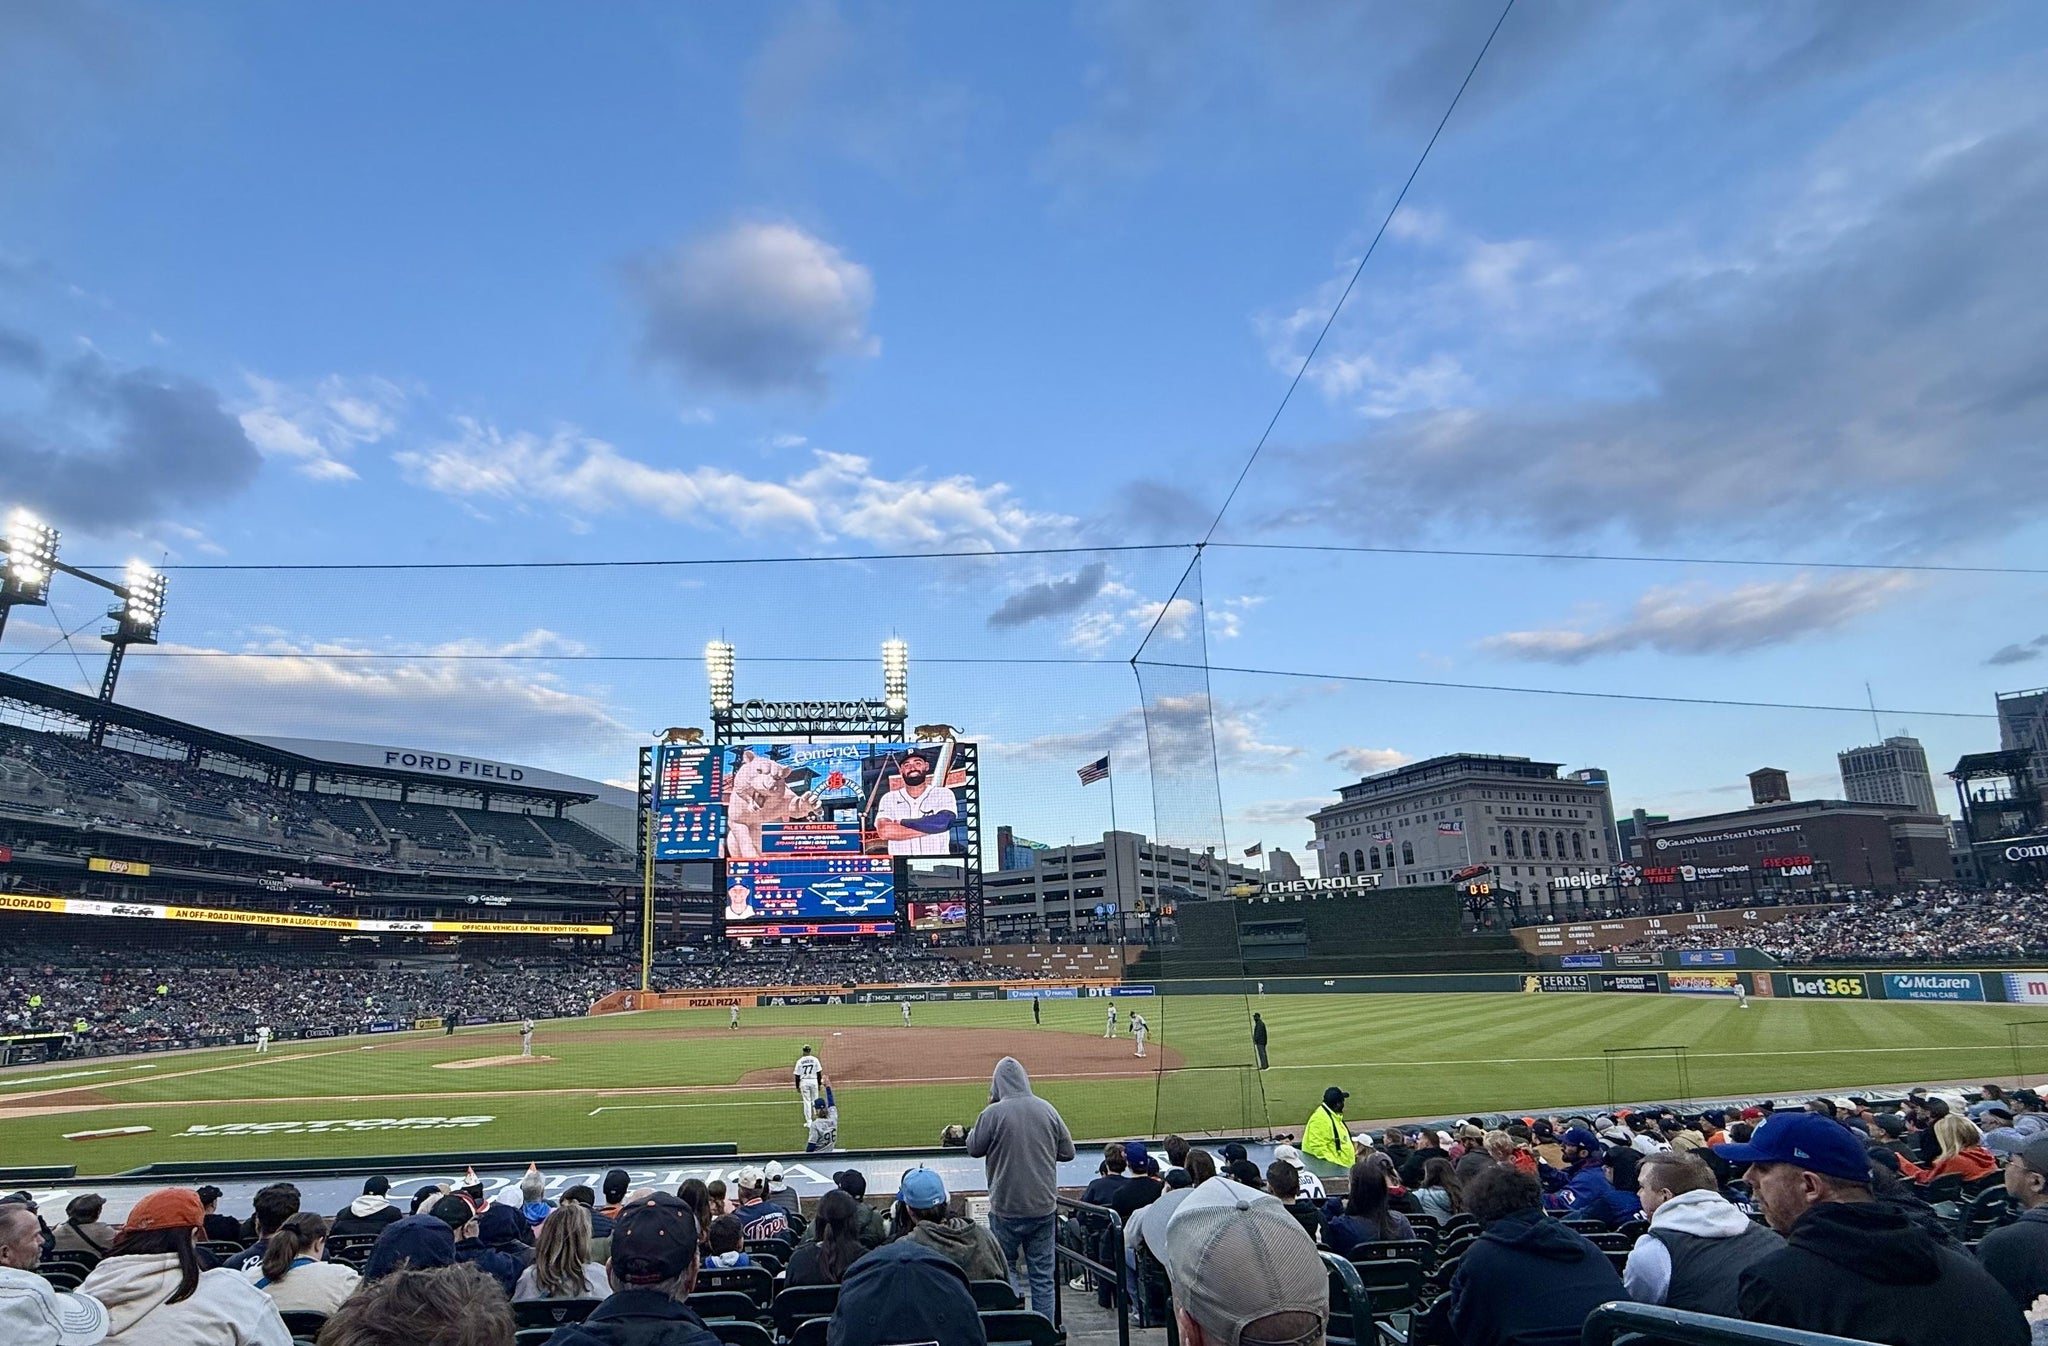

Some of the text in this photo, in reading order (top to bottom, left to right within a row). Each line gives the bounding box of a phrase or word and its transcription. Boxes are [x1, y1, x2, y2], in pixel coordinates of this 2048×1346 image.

[779, 721, 839, 731] PARK
[384, 751, 524, 781] FORD FIELD
[1668, 824, 1802, 847] GRAND VALLEY STATE UNIVERSITY
[2005, 845, 2048, 861] Com
[1763, 855, 1812, 868] FIEGER
[1643, 867, 1678, 876] BELLE
[1781, 865, 1813, 877] LAW
[1267, 873, 1383, 894] CHEVROLET
[1554, 871, 1609, 889] meijer
[1648, 876, 1674, 884] TIRE
[480, 894, 513, 903] Gallagher
[1248, 890, 1366, 905] FOUNTAIN
[175, 910, 188, 918] AN
[189, 911, 229, 920] OFF-ROAD
[230, 913, 256, 922] LINEUP
[257, 915, 280, 923] THAT'S
[295, 918, 319, 926] LEAGUE
[1695, 914, 1706, 923] 11
[1742, 910, 1758, 920] 42
[1648, 919, 1661, 928] 10
[1543, 976, 1587, 986] FERRIS
[1674, 976, 1711, 988] Surfside
[1792, 977, 1862, 995] bet365
[1914, 976, 1970, 989] McLaren
[1089, 987, 1112, 997] DTE
[1909, 991, 1938, 999] HEALTH
[689, 998, 741, 1007] PIZZA! PIZZA!
[802, 1064, 814, 1075] 77
